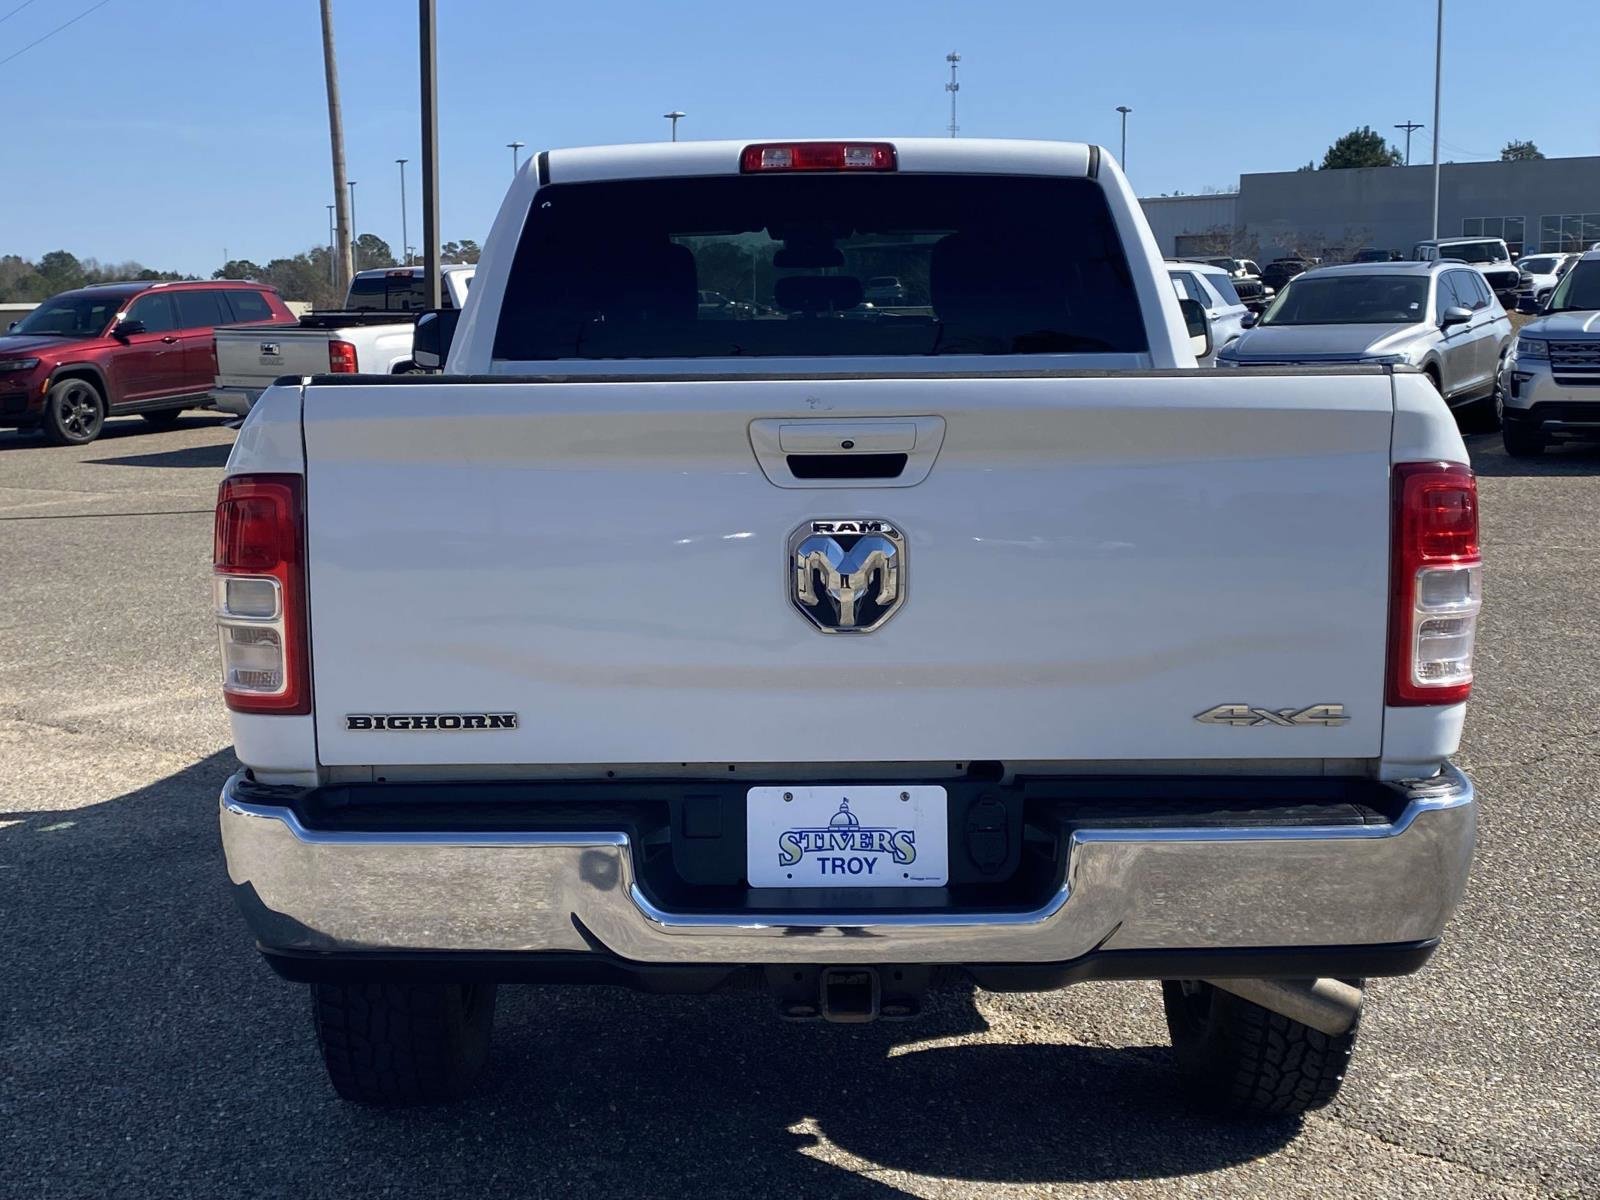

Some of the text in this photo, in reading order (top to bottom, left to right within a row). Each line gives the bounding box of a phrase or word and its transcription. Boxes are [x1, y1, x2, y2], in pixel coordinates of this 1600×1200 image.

[812, 521, 883, 534] RAM
[346, 713, 517, 731] BIGHORN
[779, 830, 917, 866] STIVERS
[817, 857, 878, 874] TROY
